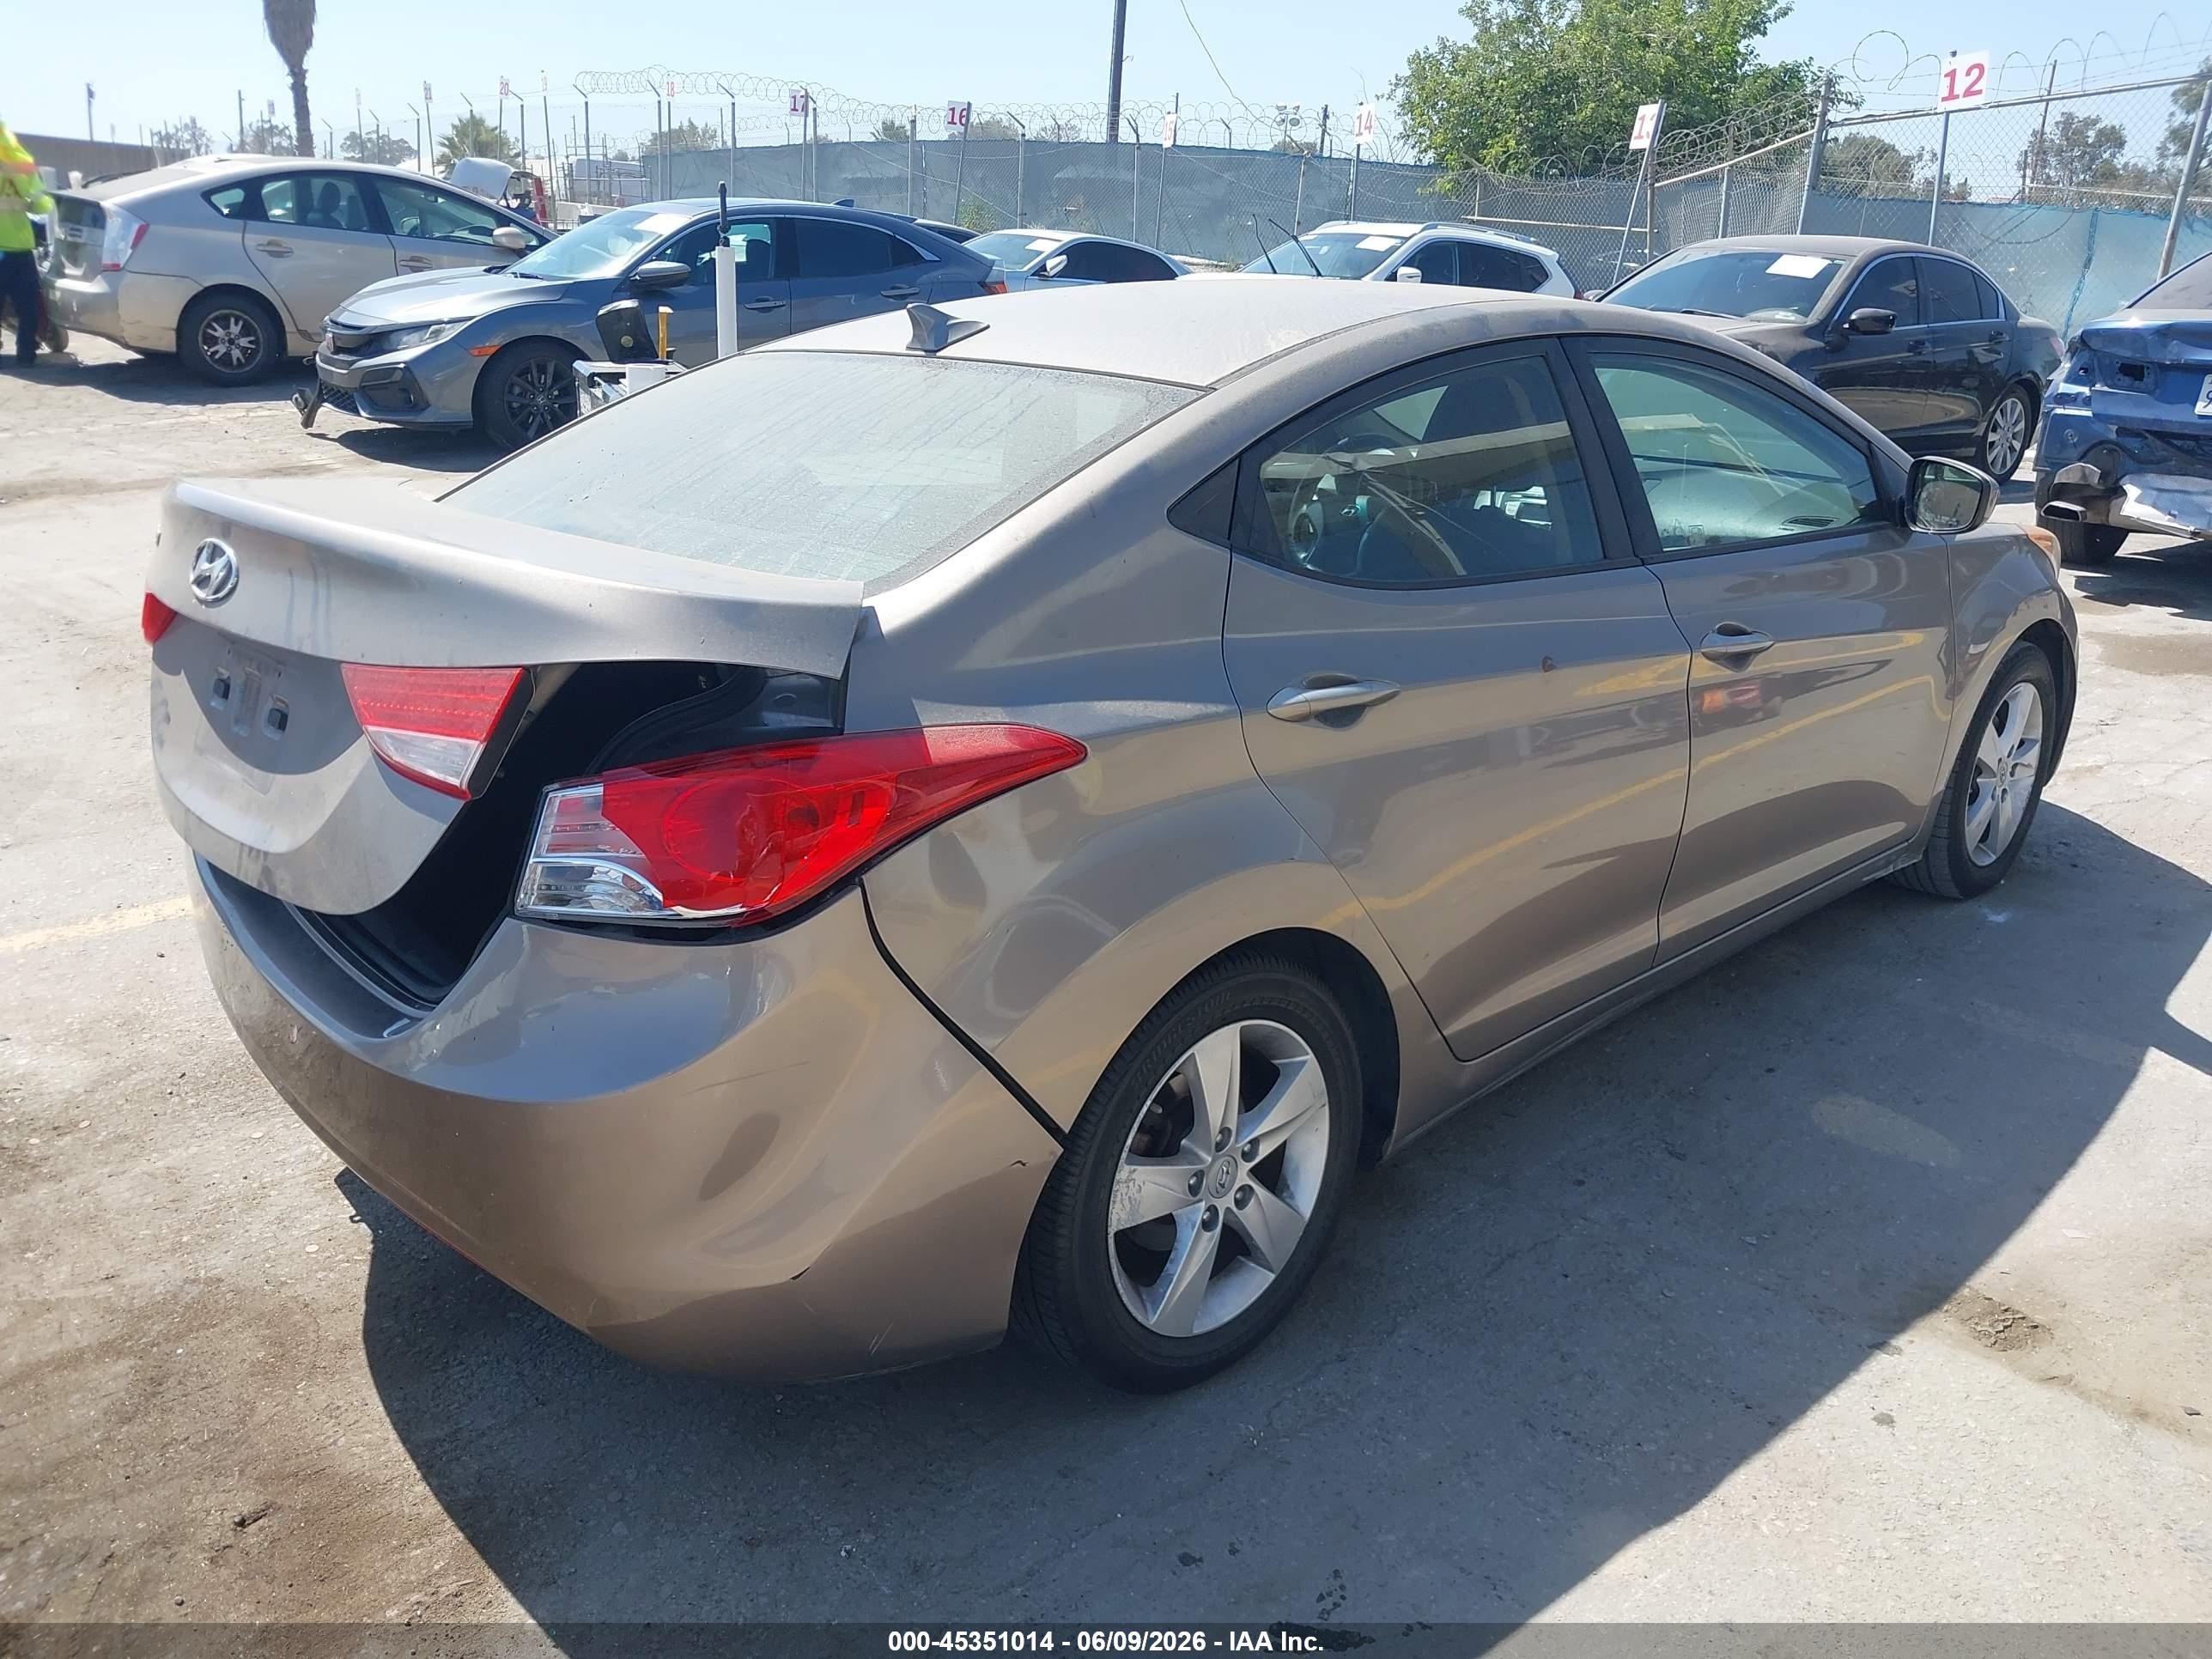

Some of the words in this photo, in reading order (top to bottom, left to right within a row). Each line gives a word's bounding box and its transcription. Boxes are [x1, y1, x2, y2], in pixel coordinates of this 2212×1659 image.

[500, 82, 509, 96] 20
[1941, 63, 1984, 101] 12
[1356, 110, 1373, 137] 14
[1633, 113, 1656, 139] 1
